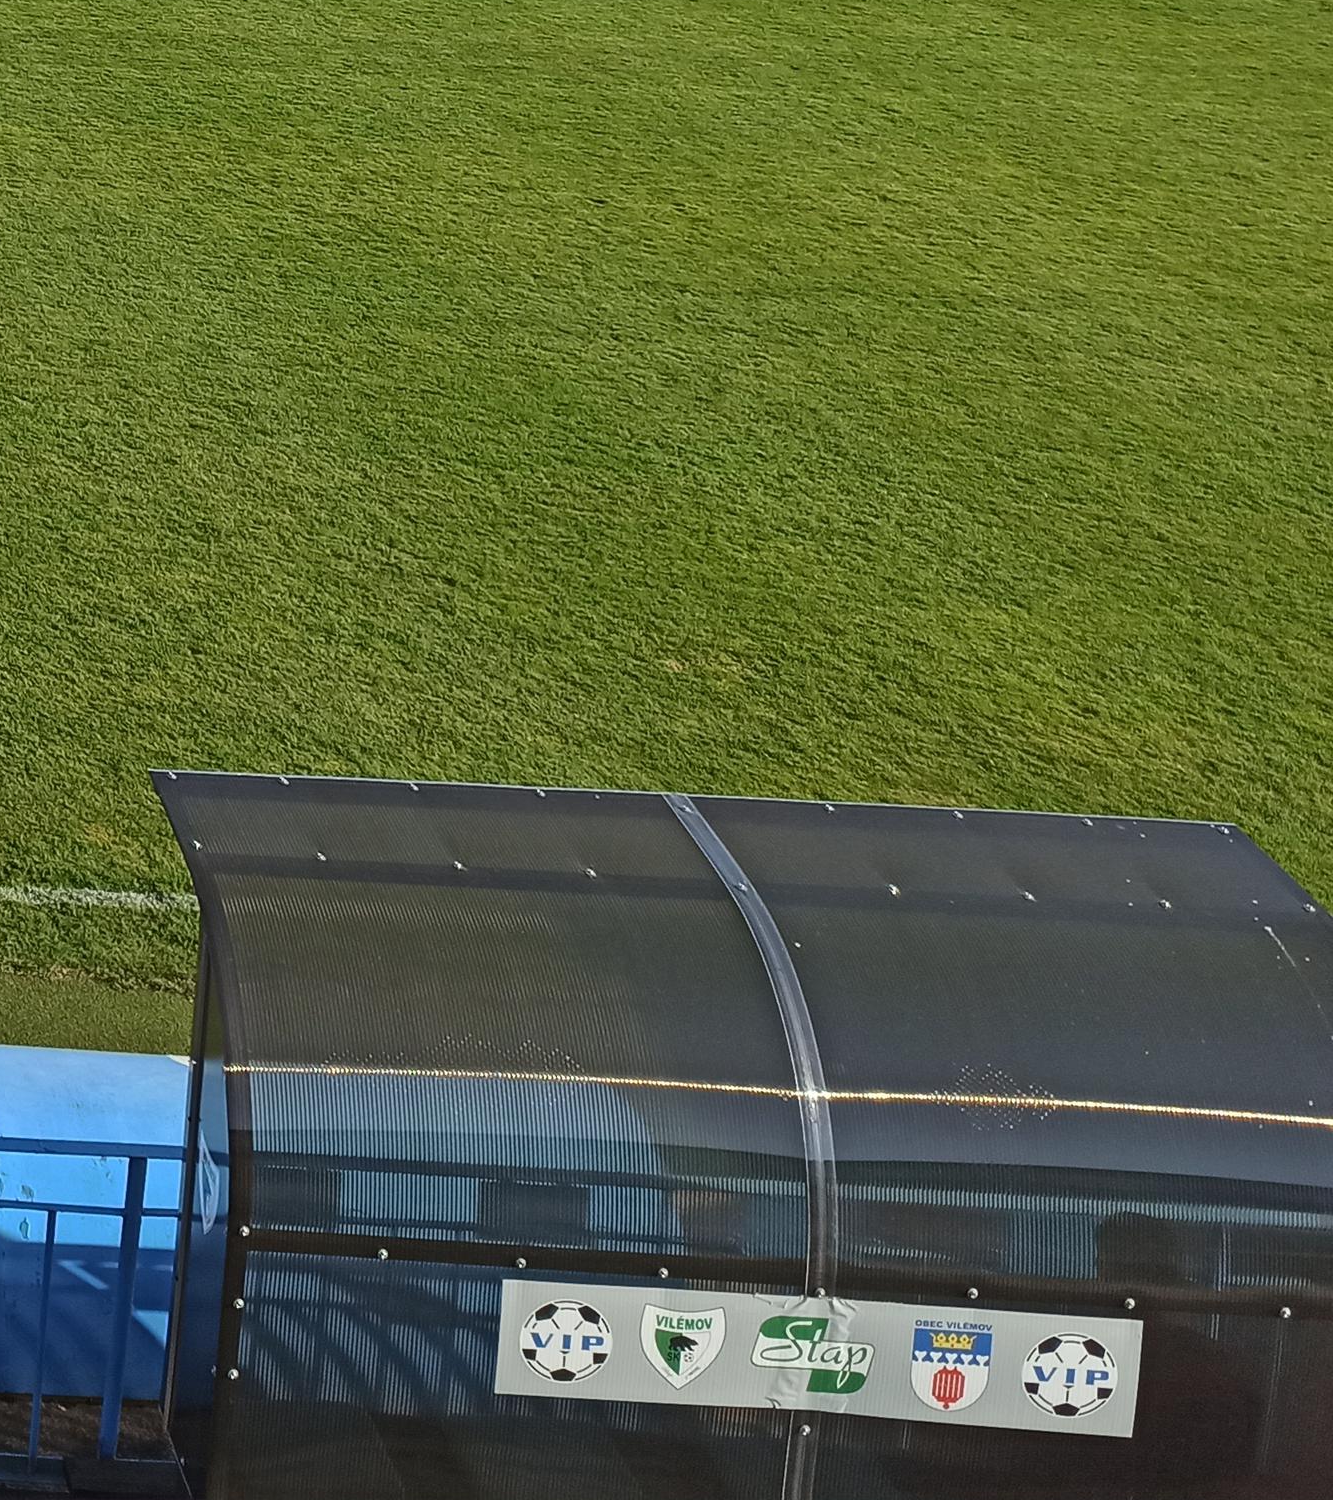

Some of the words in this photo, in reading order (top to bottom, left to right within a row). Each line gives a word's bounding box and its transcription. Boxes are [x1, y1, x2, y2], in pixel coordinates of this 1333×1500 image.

[655, 1314, 713, 1331] VILÉMOV
[915, 1319, 943, 1329] OBEC
[530, 1332, 605, 1351] VIP
[666, 1351, 681, 1363] SK
[760, 1320, 868, 1390] Stap
[1033, 1366, 1109, 1386] VIP
